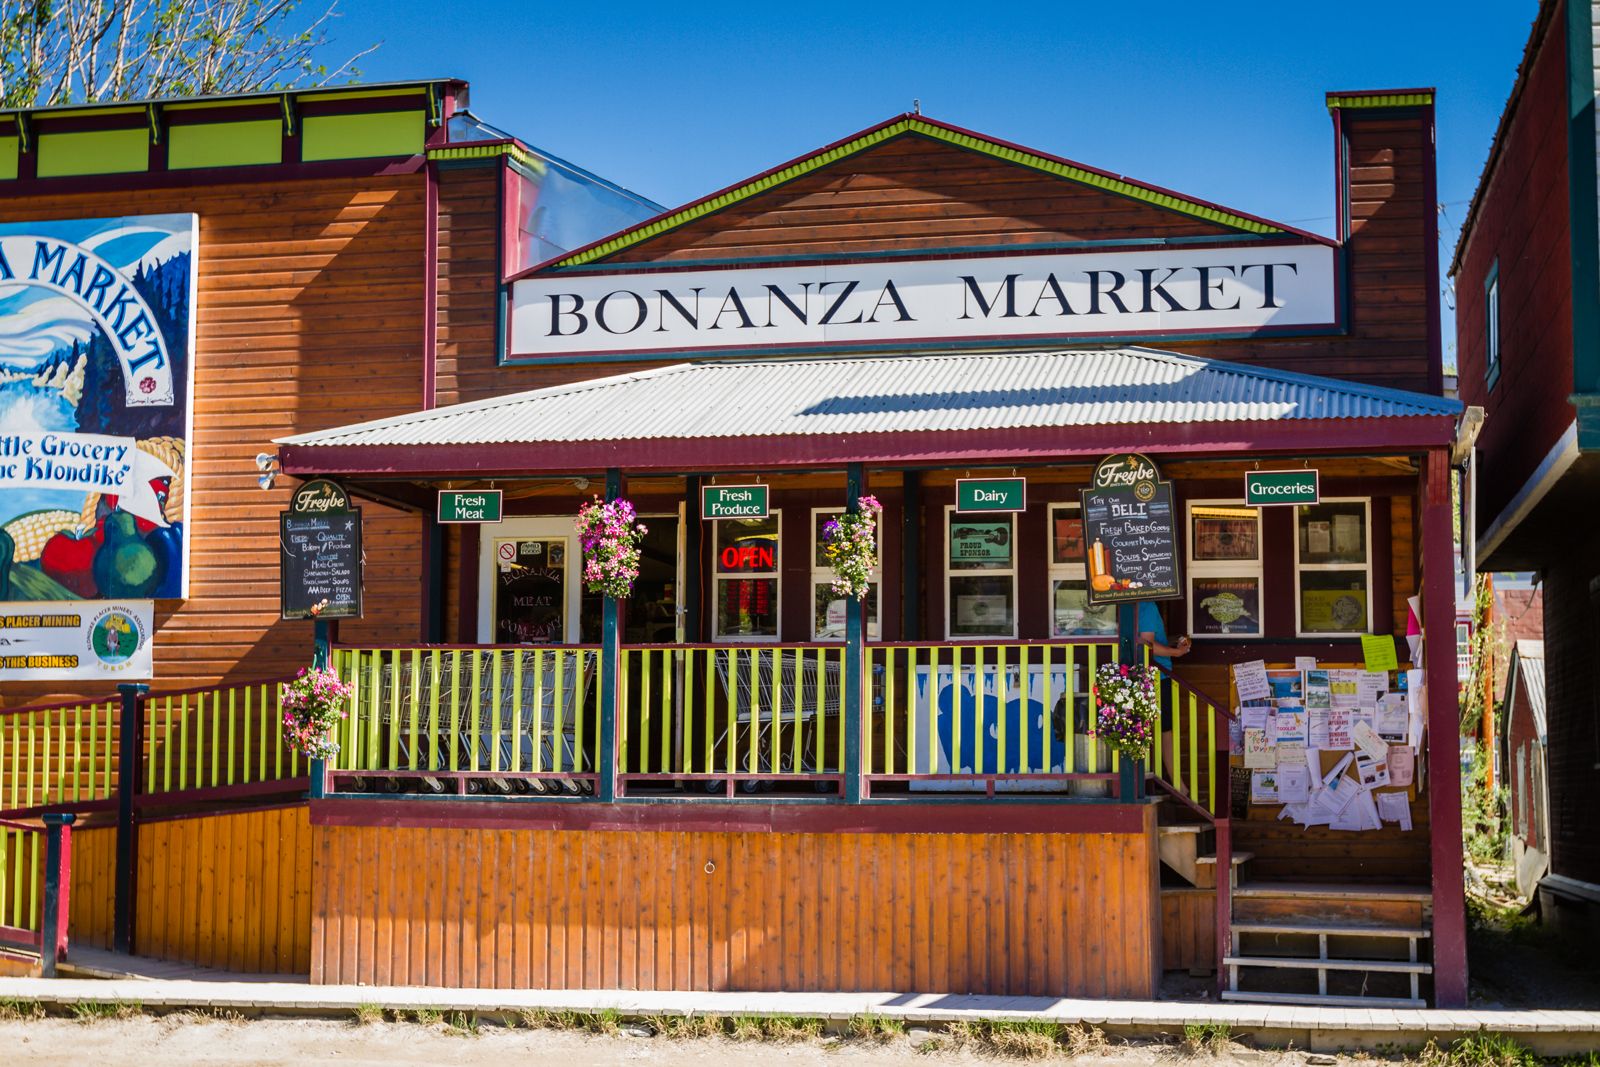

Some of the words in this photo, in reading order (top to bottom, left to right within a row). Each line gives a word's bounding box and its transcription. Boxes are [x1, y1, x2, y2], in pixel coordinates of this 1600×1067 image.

[544, 278, 916, 337] BONANZA
[957, 262, 1299, 320] MARKET
[28, 241, 166, 376] MARKET
[41, 434, 128, 461] Grocery
[1097, 460, 1154, 487] Freybe
[720, 490, 752, 501] Fresh
[1250, 482, 1314, 495] Groceries
[295, 489, 345, 512] Freybe
[454, 494, 486, 506] Fresh
[974, 489, 1008, 504] Dairy
[455, 508, 484, 519] Meat
[712, 503, 760, 515] Produce
[1112, 503, 1147, 517] DELI
[722, 546, 773, 568] OPEN
[960, 549, 991, 557] SPONSOR
[513, 596, 552, 607] MEAT
[5, 614, 41, 629] PLACER
[42, 613, 81, 628] MINING
[93, 607, 112, 622] PLACER
[501, 616, 562, 637] COMPANY
[5, 656, 27, 669] THIS
[27, 655, 79, 669] BUSINESS
